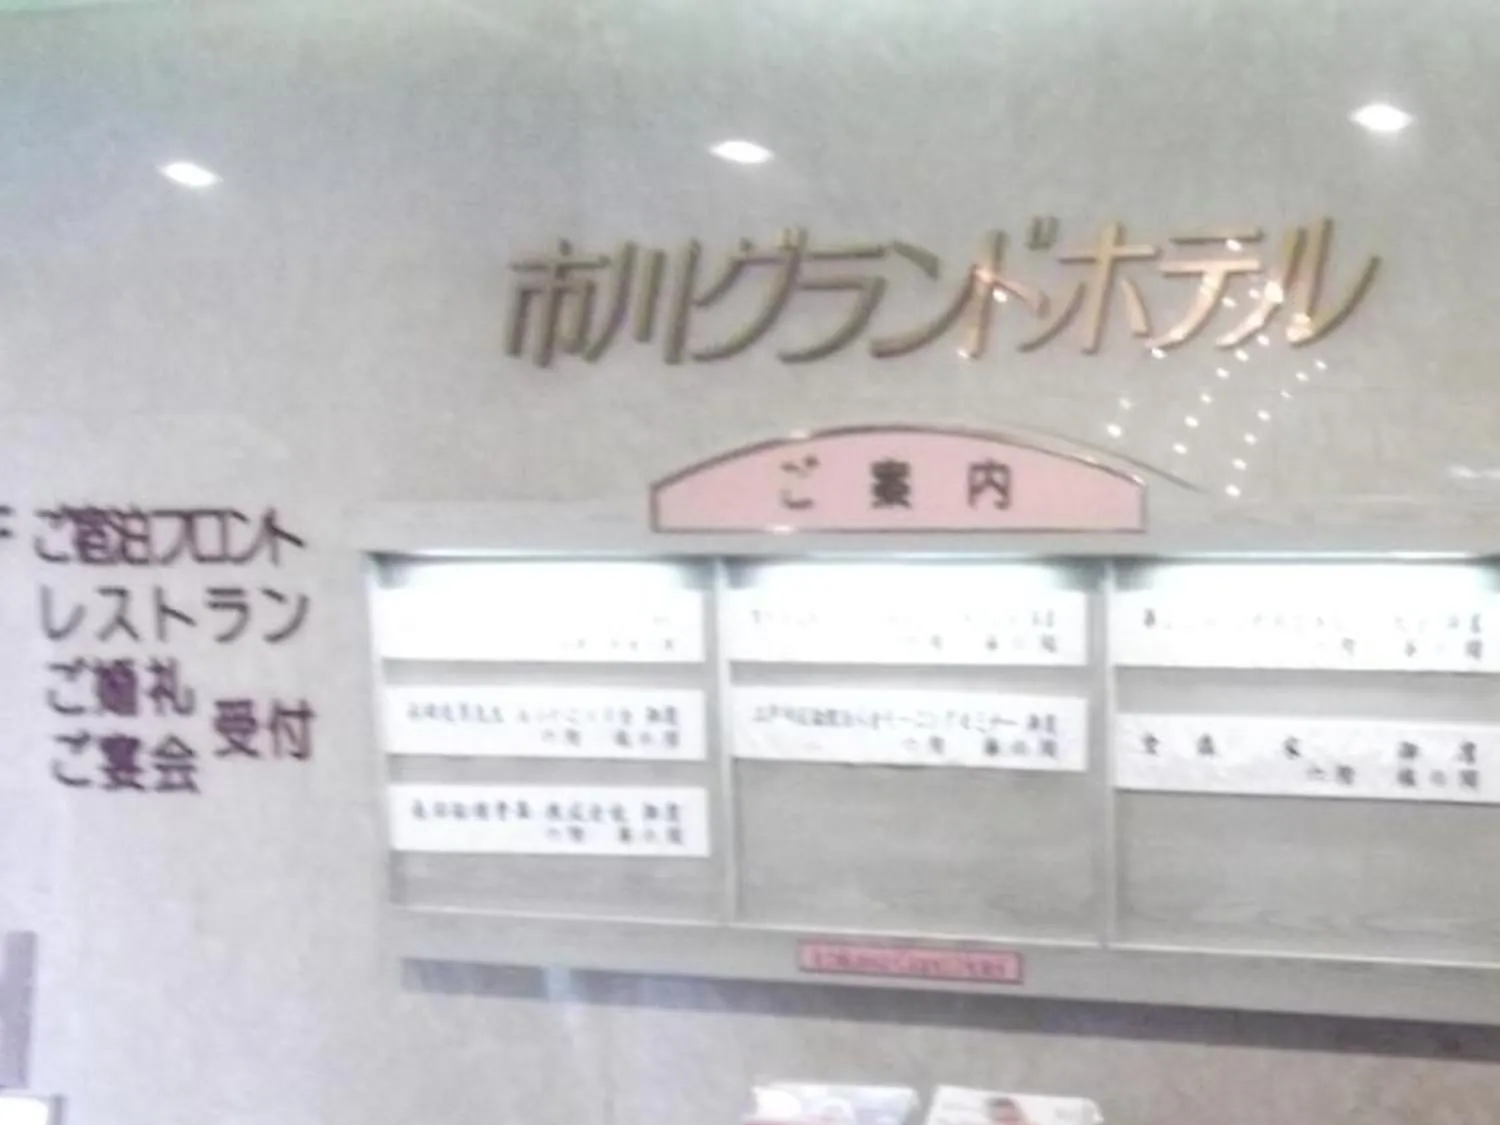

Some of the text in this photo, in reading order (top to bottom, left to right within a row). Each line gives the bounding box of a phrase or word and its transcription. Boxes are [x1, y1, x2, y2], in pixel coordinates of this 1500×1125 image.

[503, 215, 1382, 368] 市川グランドホテル
[779, 454, 1012, 509] ご案内
[40, 585, 310, 642] レストラン
[212, 698, 317, 763] 受付
